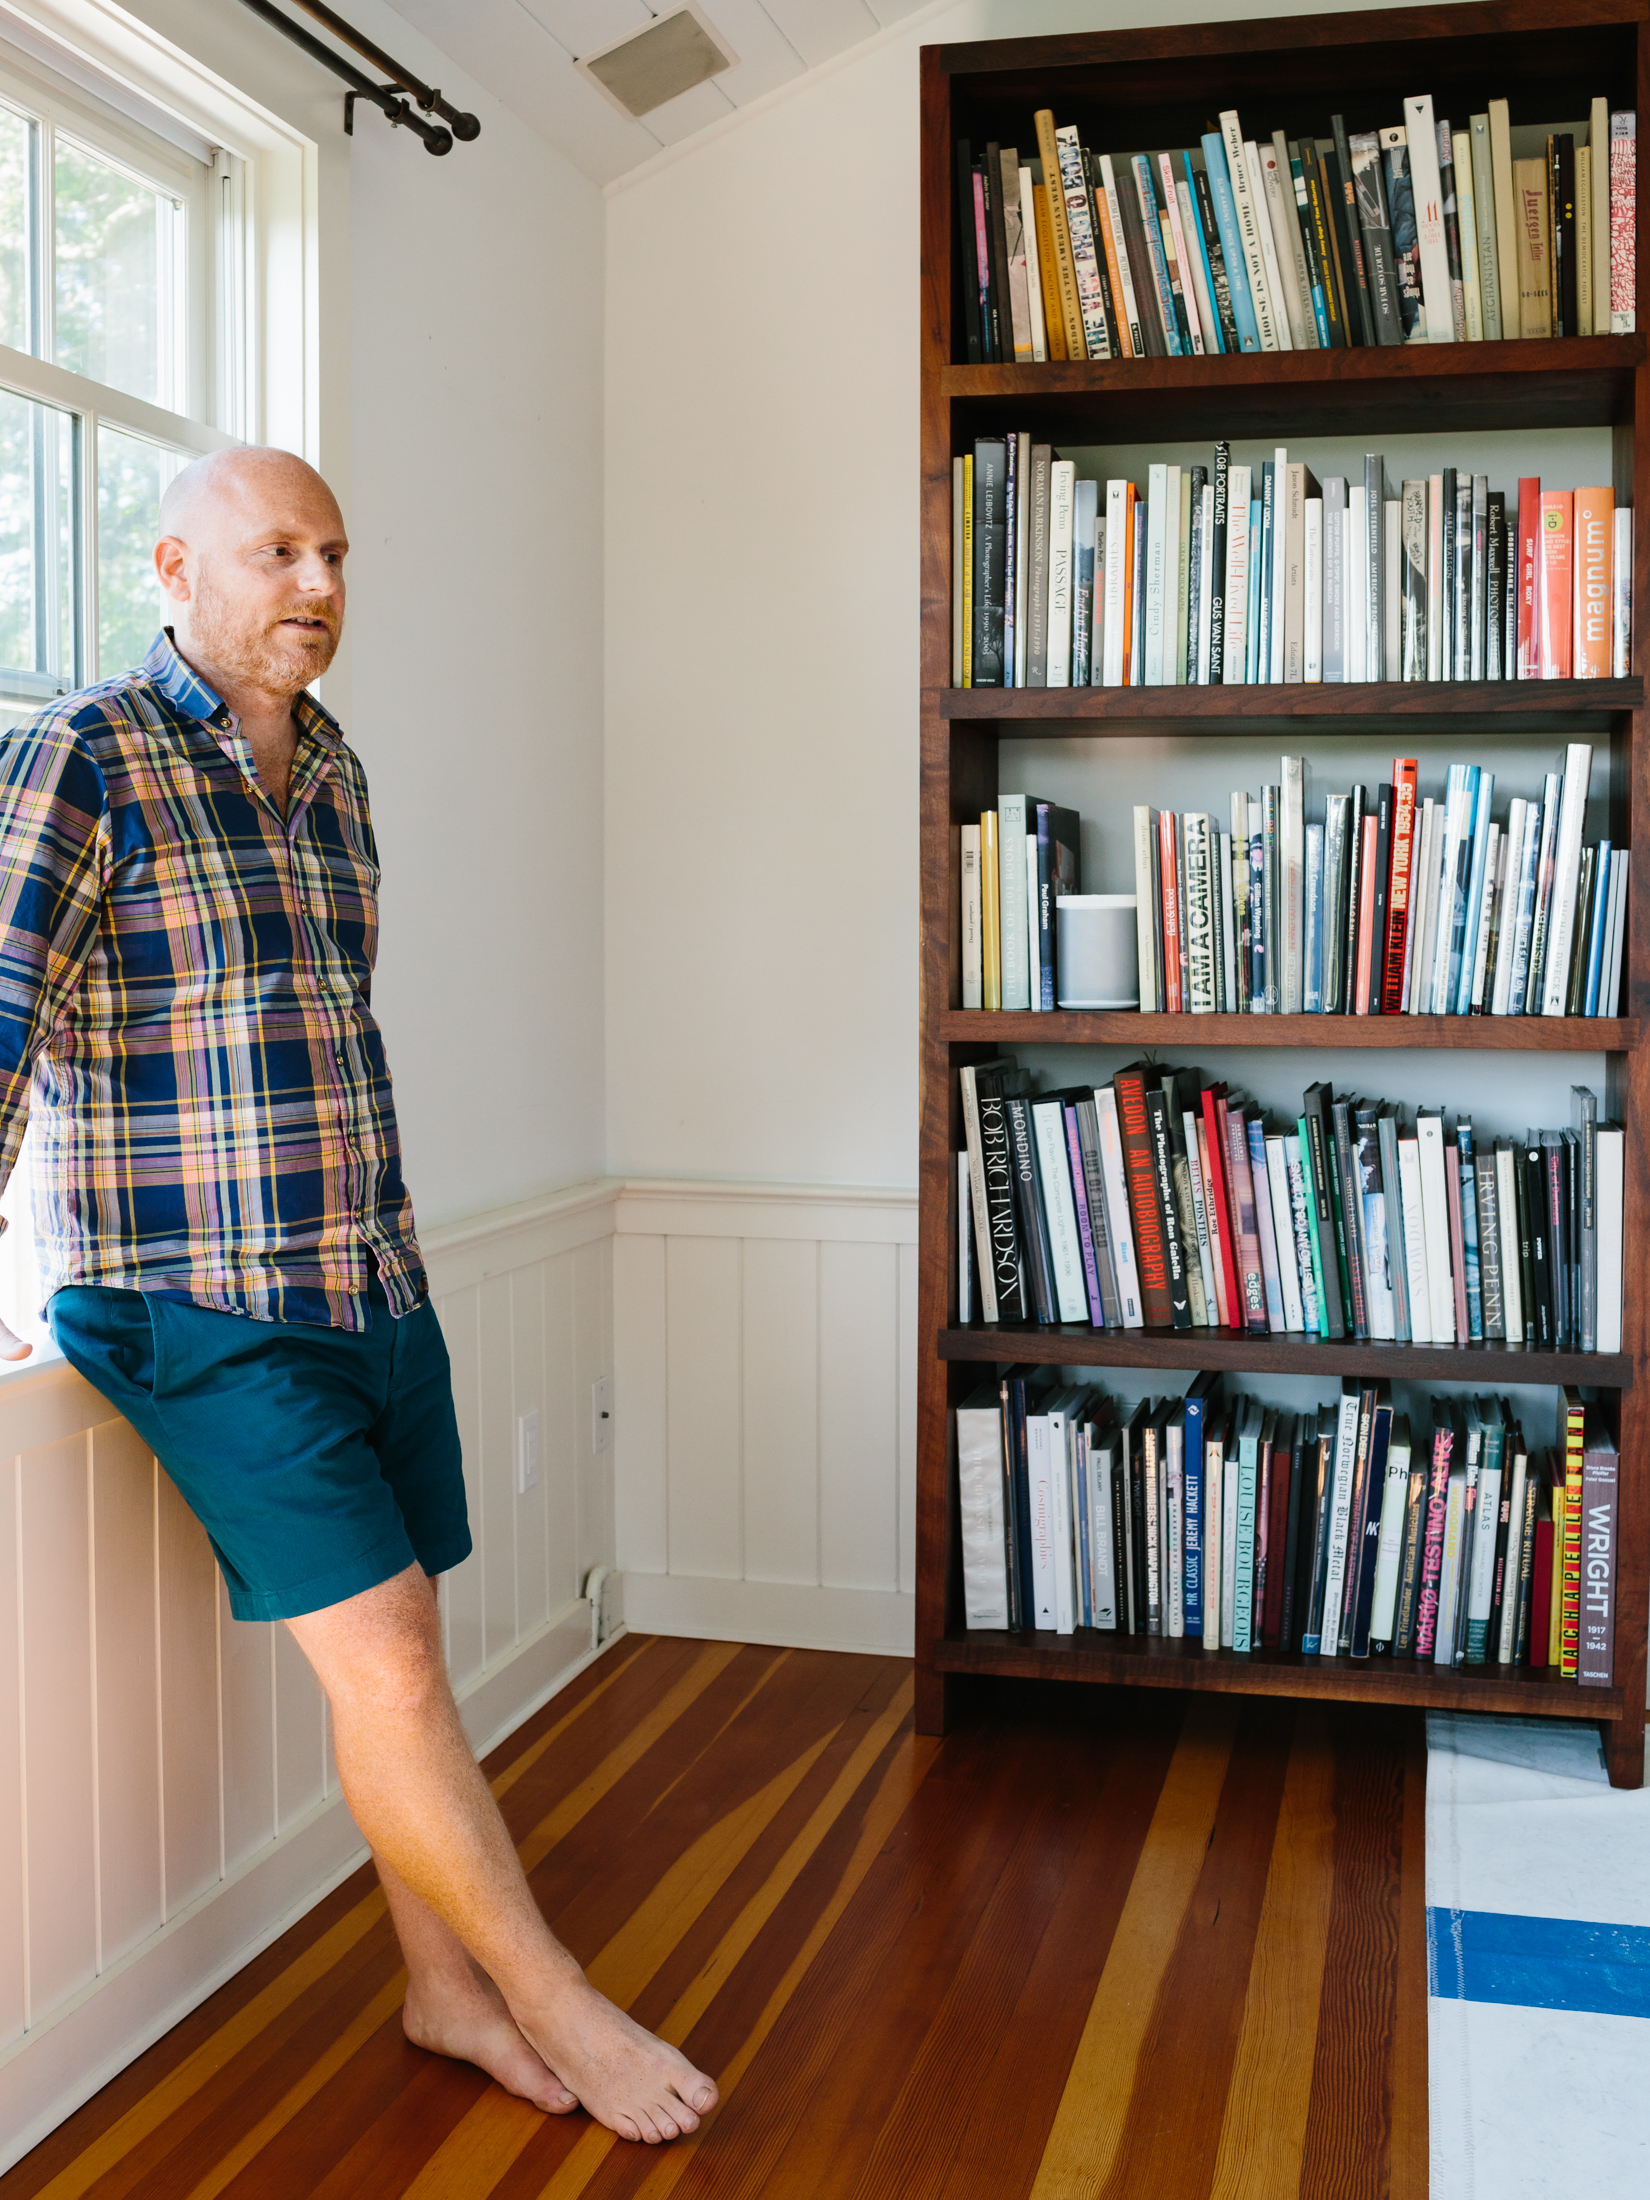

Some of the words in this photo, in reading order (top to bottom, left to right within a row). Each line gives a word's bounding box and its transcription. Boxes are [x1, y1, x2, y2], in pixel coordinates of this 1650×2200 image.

[1230, 127, 1239, 158] Weber
[1057, 133, 1083, 190] BOOK
[1163, 165, 1172, 183] Skin
[1236, 162, 1247, 193] Bruce
[1038, 188, 1046, 218] WILLIAM
[1049, 173, 1058, 203] WEST
[1166, 186, 1175, 204] Fruit
[1217, 178, 1225, 194] SLIM
[1180, 189, 1190, 213] Juergen
[1185, 214, 1194, 231] Teller
[1219, 196, 1229, 222] AARONS
[1242, 202, 1253, 236] HOME
[1526, 189, 1543, 239] Juergen
[1041, 220, 1051, 263] EGGLESTON
[1053, 205, 1066, 261] AMERICAN
[1066, 194, 1093, 263] PHOTO
[1226, 229, 1234, 246] ONCE
[1251, 254, 1261, 275] NOT
[1531, 242, 1543, 261] Teller
[1046, 269, 1055, 301] ANCIENT
[1061, 266, 1070, 287] THE
[1077, 268, 1102, 315] VICE
[1256, 281, 1263, 293] IS
[1377, 273, 1385, 286] SO
[1482, 236, 1495, 321] AFGHANISTAN
[1065, 289, 1072, 302] IN
[1379, 287, 1387, 302] FAR
[1381, 302, 1389, 314] SO
[1259, 297, 1273, 337] HOUSE
[1052, 321, 1060, 353] MODERN
[1069, 317, 1079, 359] AVEDON
[1086, 318, 1108, 360] THE
[1217, 451, 1227, 470] 108
[1036, 461, 1045, 505] NORMAN
[1057, 470, 1069, 501] Irving
[1290, 470, 1299, 488] Jason
[985, 490, 993, 529] LEIBOVITZ
[1215, 473, 1226, 525] PORTRAITS
[1291, 491, 1299, 519] Schmidt
[1059, 504, 1068, 529] Penn
[1231, 503, 1246, 531] The
[1490, 505, 1500, 534] Robert
[1035, 507, 1044, 562] PARKINSON
[983, 543, 992, 593] Photographer's
[1149, 542, 1160, 594] Sherman
[1490, 538, 1500, 573] Maxwell
[1033, 566, 1042, 611] Photographs
[1054, 550, 1067, 615] PASSAGE
[1229, 535, 1246, 615] Well-Lived
[1290, 563, 1299, 585] Artists
[1587, 521, 1609, 641] magnum
[983, 594, 992, 608] Life
[1148, 601, 1161, 635] Cindy
[1212, 597, 1222, 619] GUS
[1211, 622, 1222, 643] VAN
[1228, 621, 1245, 649] Life
[1211, 646, 1221, 674] SANT
[1290, 642, 1298, 667] Edition
[1290, 669, 1297, 679] 7L
[1396, 783, 1413, 835] 1954.55
[1187, 818, 1208, 928] CAMERA
[1394, 839, 1409, 874] YORK
[1166, 889, 1175, 909] blood
[1391, 877, 1408, 909] NEW
[1166, 918, 1175, 936] flesh
[1190, 933, 1209, 949] A
[1390, 912, 1405, 949] KLEIN
[1191, 955, 1211, 995] AM
[1385, 953, 1404, 1011] WILLIAM
[981, 1098, 1004, 1144] BOB
[1120, 1079, 1146, 1135] AVEDON
[1154, 1110, 1162, 1131] The
[1011, 1107, 1032, 1181] MONDINO
[1069, 1130, 1079, 1162] SIMEN
[1128, 1149, 1150, 1168] AN
[1074, 1165, 1083, 1197] JOHAN
[1154, 1134, 1169, 1201] Photographs
[1190, 1160, 1201, 1194] BEUYS
[1164, 1204, 1173, 1214] of
[1206, 1179, 1217, 1216] Ethridge
[1479, 1170, 1497, 1254] IRVING
[986, 1151, 1018, 1299] RICHARDSON
[1079, 1204, 1087, 1233] ROOM
[1131, 1174, 1165, 1290] AUTOBIOGRAPHY
[1166, 1217, 1175, 1240] Ron
[1195, 1200, 1208, 1247] POSTERS
[1084, 1236, 1090, 1248] TO
[1085, 1253, 1094, 1275] PLAY
[1169, 1242, 1181, 1280] Galella
[1246, 1272, 1260, 1310] edges
[1485, 1265, 1501, 1327] PENN
[1344, 1403, 1357, 1431] True
[1145, 1433, 1155, 1468] SAFETY
[1338, 1435, 1353, 1500] Norwegian
[1431, 1435, 1451, 1492] ALIVE
[1146, 1469, 1155, 1477] IN
[1389, 1466, 1407, 1481] Ph
[1146, 1478, 1156, 1525] NUMBERS:
[1186, 1474, 1198, 1513] HACKETT
[1239, 1465, 1254, 1534] LOUISE
[1035, 1480, 1051, 1569] Cosmigraphics
[1095, 1505, 1105, 1528] BILL
[1334, 1507, 1350, 1540] Black
[1409, 1504, 1420, 1544] Musicians
[1447, 1486, 1460, 1558] WINOGRAND
[1481, 1493, 1492, 1531] ATLAS
[1147, 1526, 1157, 1547] NICK
[1186, 1518, 1200, 1550] JEREMY
[1422, 1499, 1443, 1582] TESTINO
[1097, 1532, 1107, 1576] BRANDT
[1331, 1545, 1343, 1581] Metal
[1405, 1546, 1415, 1583] American
[1587, 1504, 1610, 1617] WRIGHT
[1148, 1548, 1158, 1605] WAPLINGTON
[1187, 1556, 1197, 1588] CLASSIC
[1187, 1593, 1197, 1605] MR
[1235, 1541, 1253, 1648] BOURGEOIS
[1400, 1588, 1413, 1631] Friedlander
[1417, 1589, 1438, 1654] MARIO
[1587, 1626, 1605, 1635] 1917
[1399, 1634, 1408, 1649] Lee
[1586, 1642, 1606, 1650] 1942
